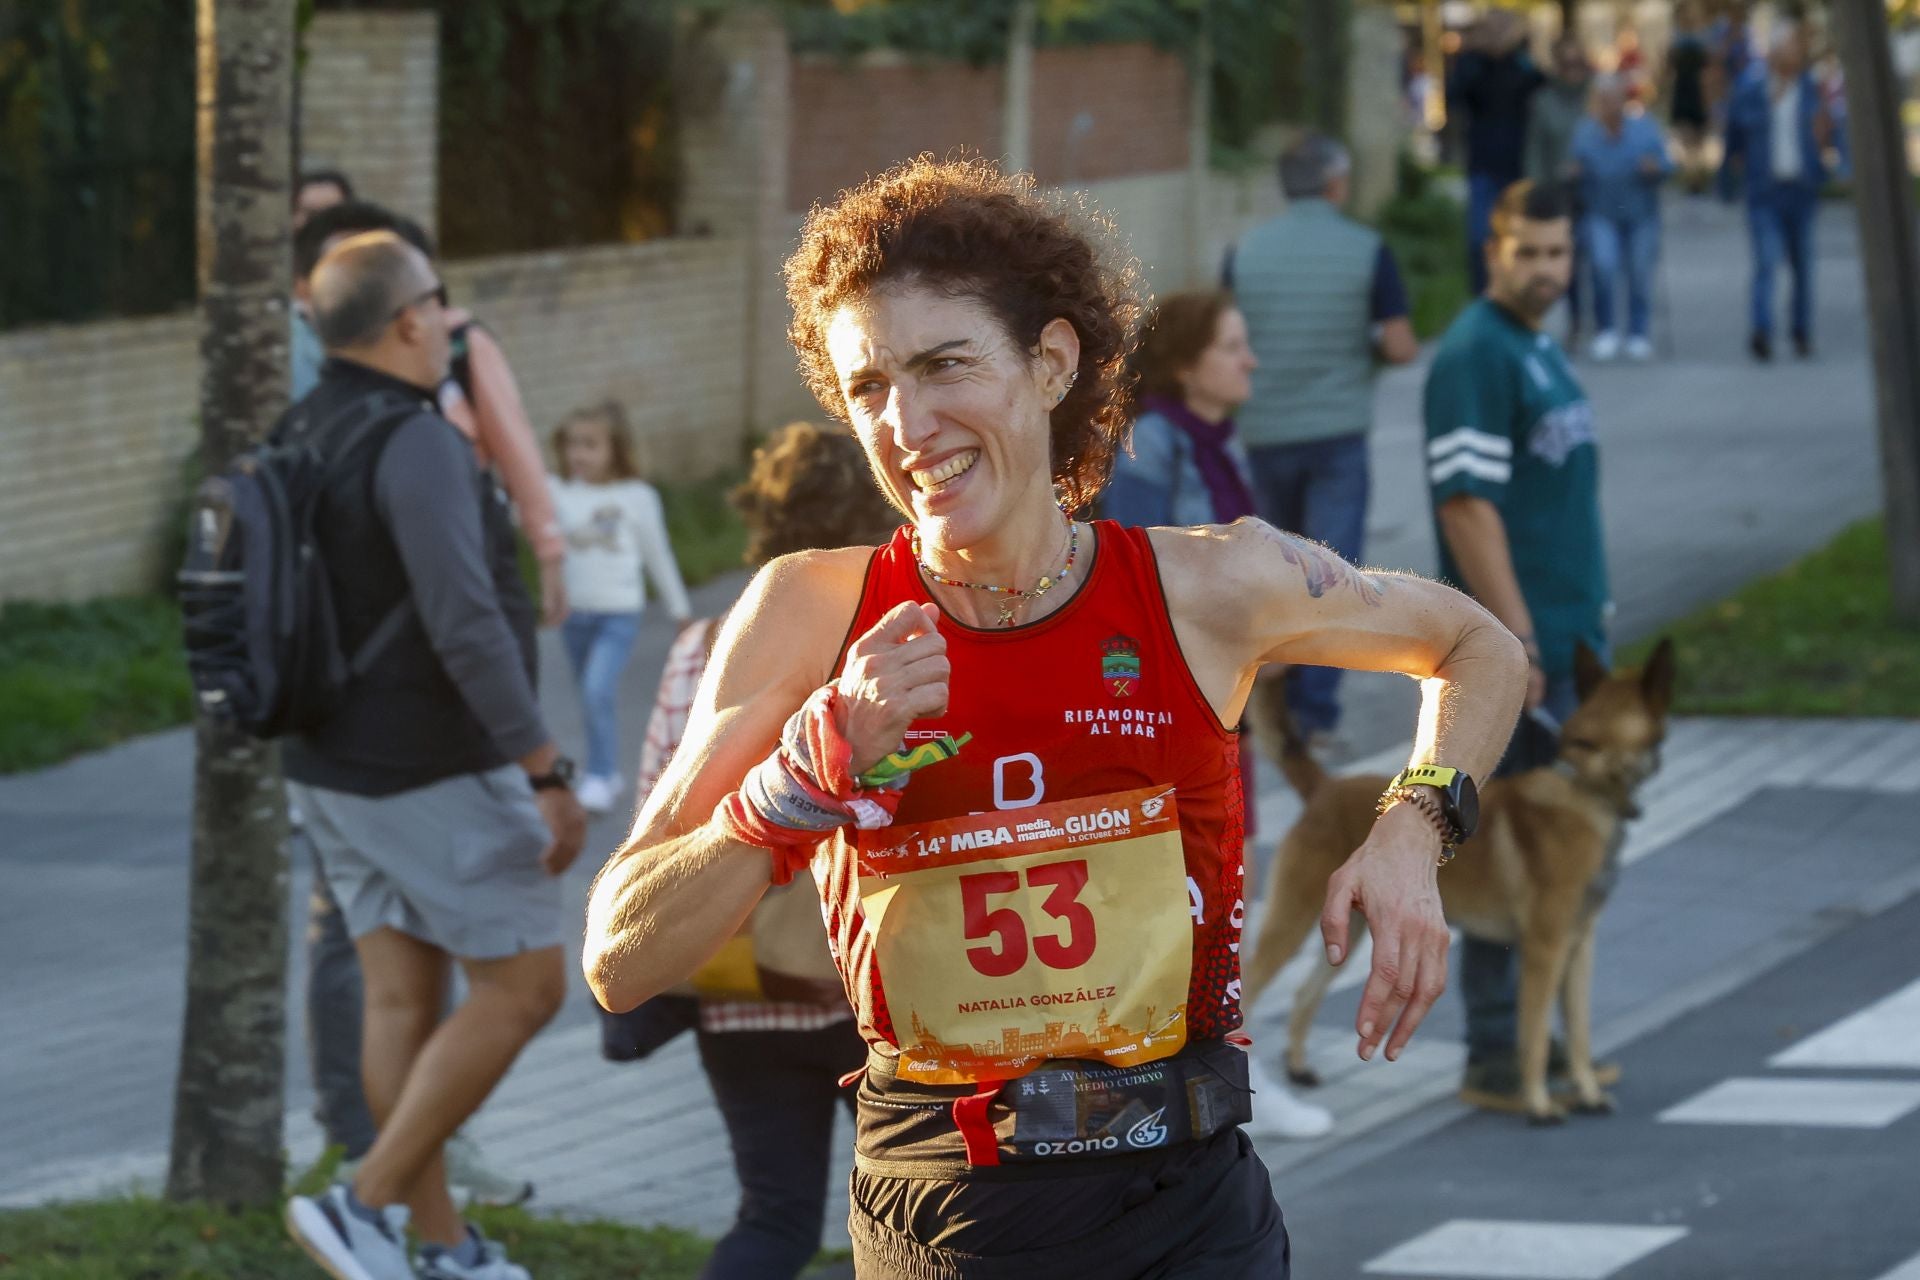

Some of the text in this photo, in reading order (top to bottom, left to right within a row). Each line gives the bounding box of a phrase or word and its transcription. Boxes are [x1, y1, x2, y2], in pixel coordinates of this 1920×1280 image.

[1090, 722, 1155, 738] AL MAR
[1016, 818, 1050, 833] media
[1065, 808, 1131, 834] GIJÓN
[951, 826, 1014, 852] MBA
[1017, 826, 1065, 843] maratón
[1078, 830, 1113, 842] OCTUBRE
[1114, 827, 1131, 837] 2025
[959, 859, 1097, 977] 53
[958, 986, 1117, 1014] NATALIA GONZÁLEZ
[1103, 1043, 1138, 1056] SIROKO
[1073, 1071, 1163, 1093] MEDIO CUDEYO
[1034, 1135, 1119, 1156] ozono
